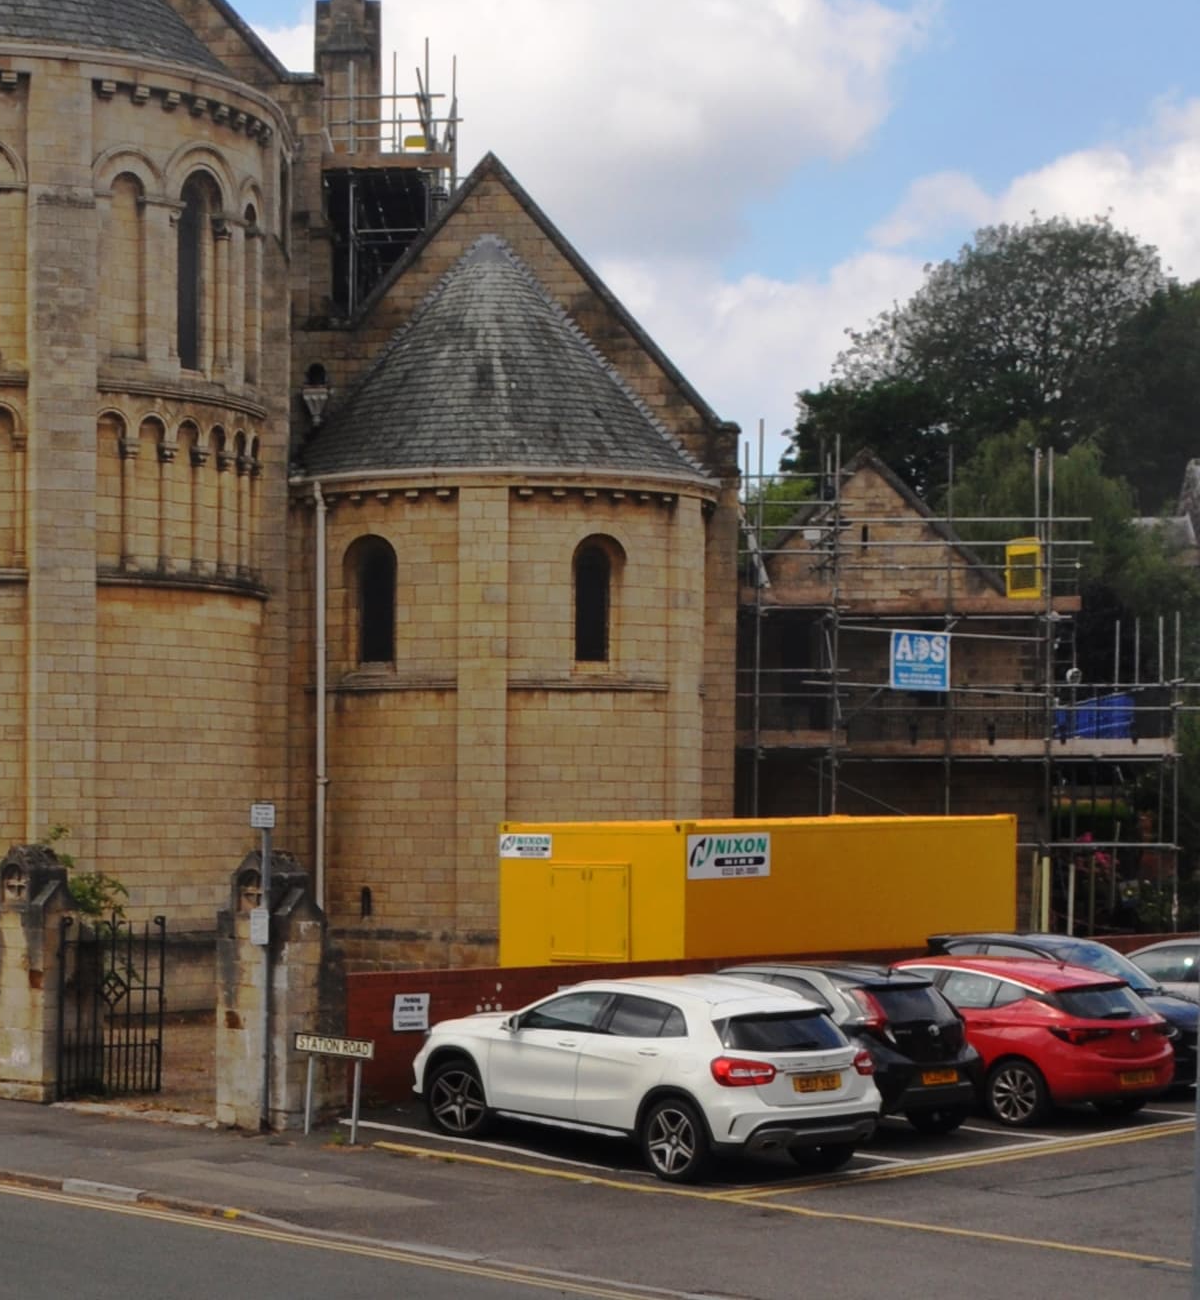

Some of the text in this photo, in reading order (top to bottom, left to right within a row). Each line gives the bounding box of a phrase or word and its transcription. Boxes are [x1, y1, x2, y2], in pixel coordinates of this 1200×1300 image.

[516, 836, 550, 845] NIXON
[715, 837, 767, 854] NIXON
[299, 1036, 369, 1055] STATION ROAD
